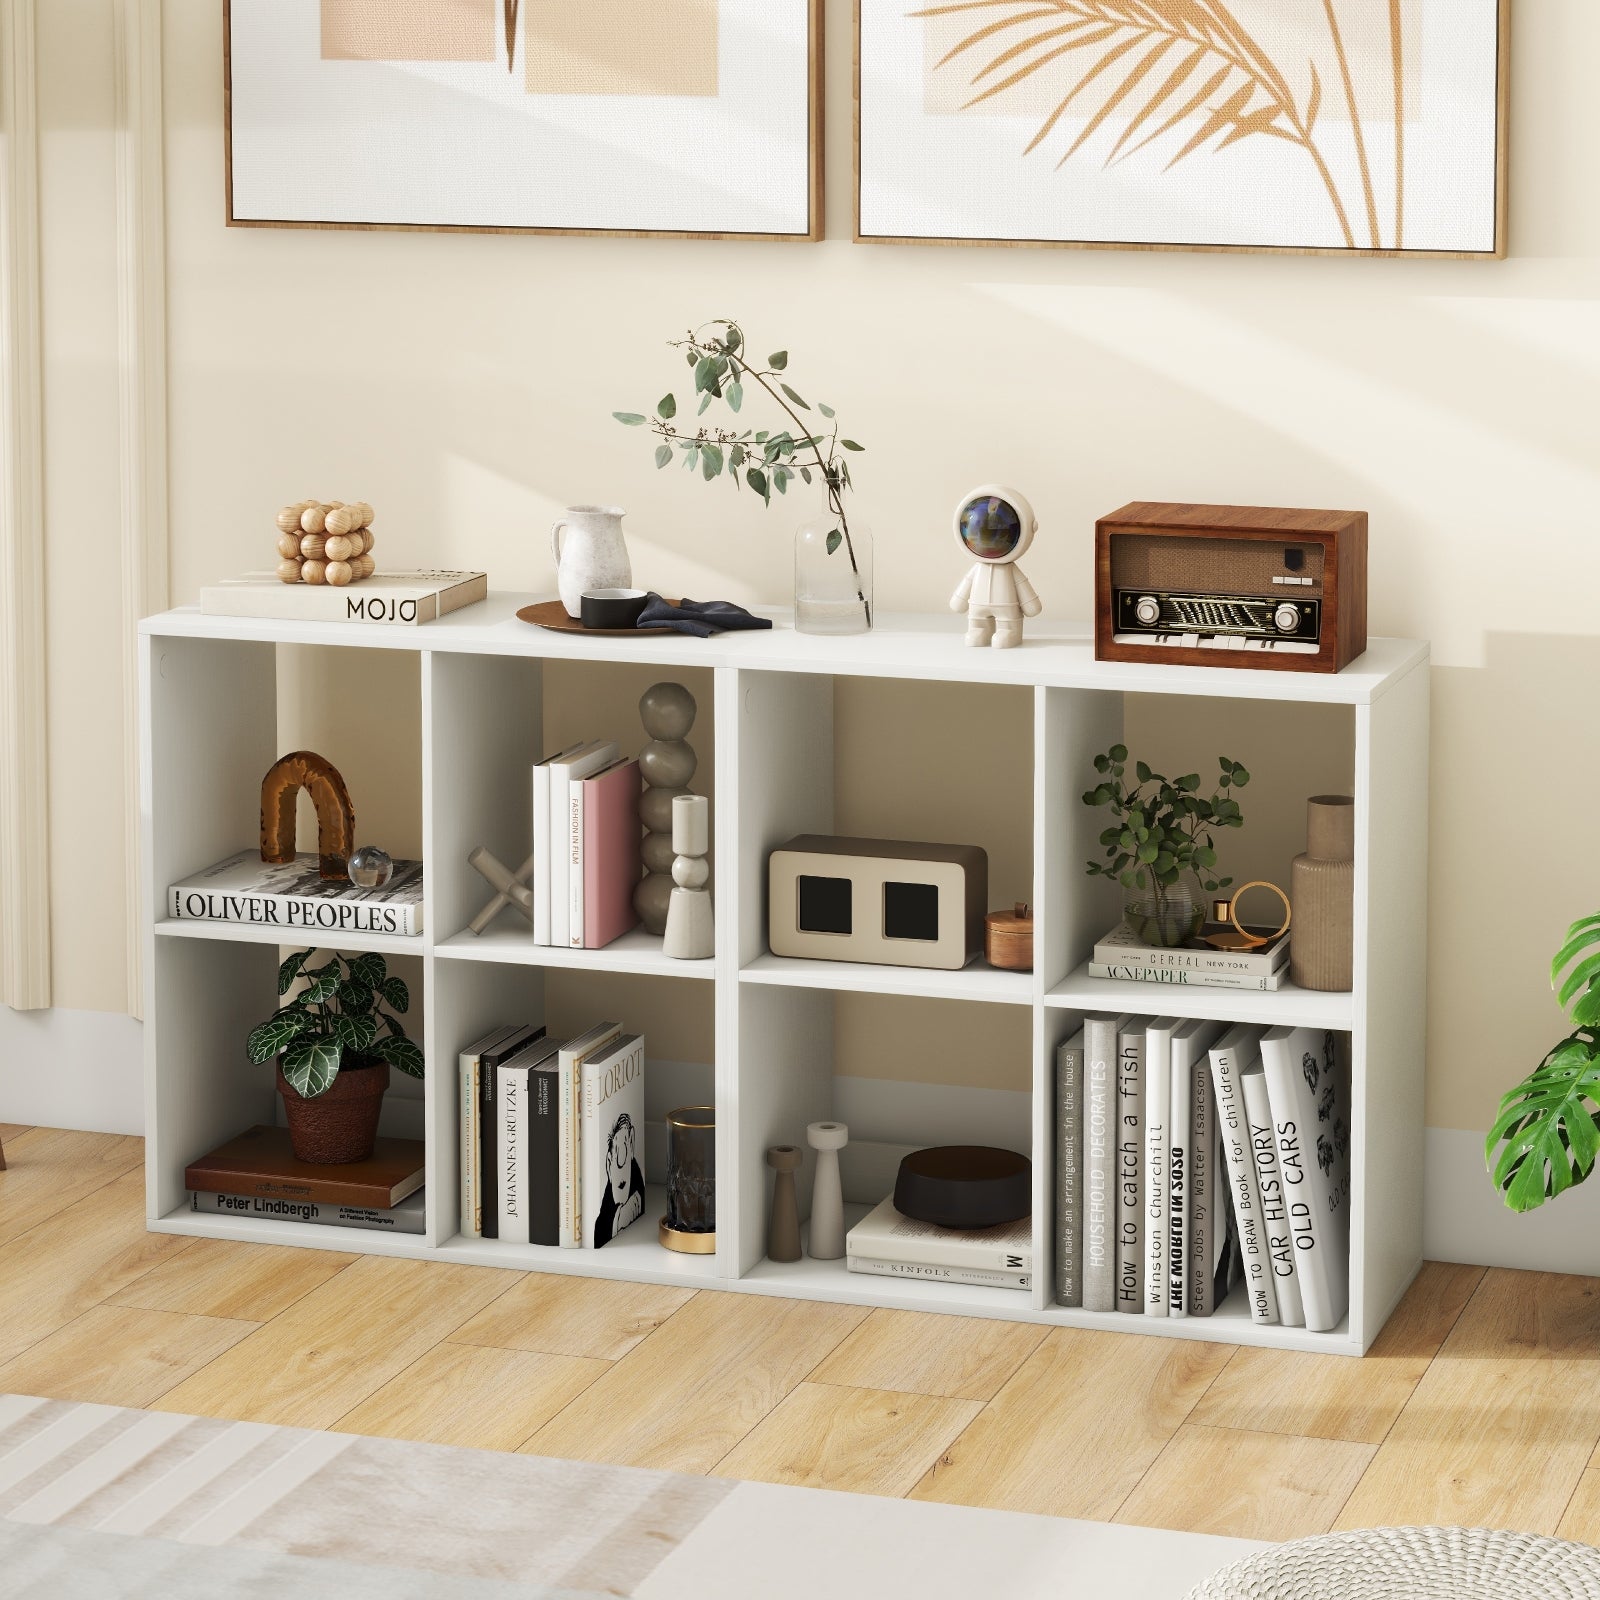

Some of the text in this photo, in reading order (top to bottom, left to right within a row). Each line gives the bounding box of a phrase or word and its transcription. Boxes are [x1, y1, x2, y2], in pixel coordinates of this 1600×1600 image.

[571, 798, 580, 865] FASHION IN FILM
[186, 893, 280, 924] OLIVER
[287, 900, 397, 933] PEOPLES
[1150, 953, 1201, 968] CEREAL
[1206, 960, 1225, 968] NEW
[1227, 962, 1249, 970] YORK
[597, 1047, 643, 1105] LORIOT
[217, 1194, 250, 1211] Peter
[254, 1198, 320, 1220] Lindbergh
[505, 1146, 518, 1218] JOHANNES
[1063, 1054, 1076, 1297] How to make an arrangement in the house
[1089, 1060, 1106, 1267] HOUSEHOLD DECORATES
[1119, 1046, 1138, 1302] How to catch a fish
[1193, 1071, 1206, 1311] Steve Jobs by Walter Isaacson
[1218, 1057, 1269, 1317] HOW TO DRAW Book for children
[1251, 1124, 1294, 1277] CAR HISTORY
[1277, 1121, 1315, 1250] OLD CARS
[1006, 1255, 1023, 1268] M
[1149, 1124, 1162, 1304] Winston Churchill
[891, 1264, 951, 1277] KINFOLK
